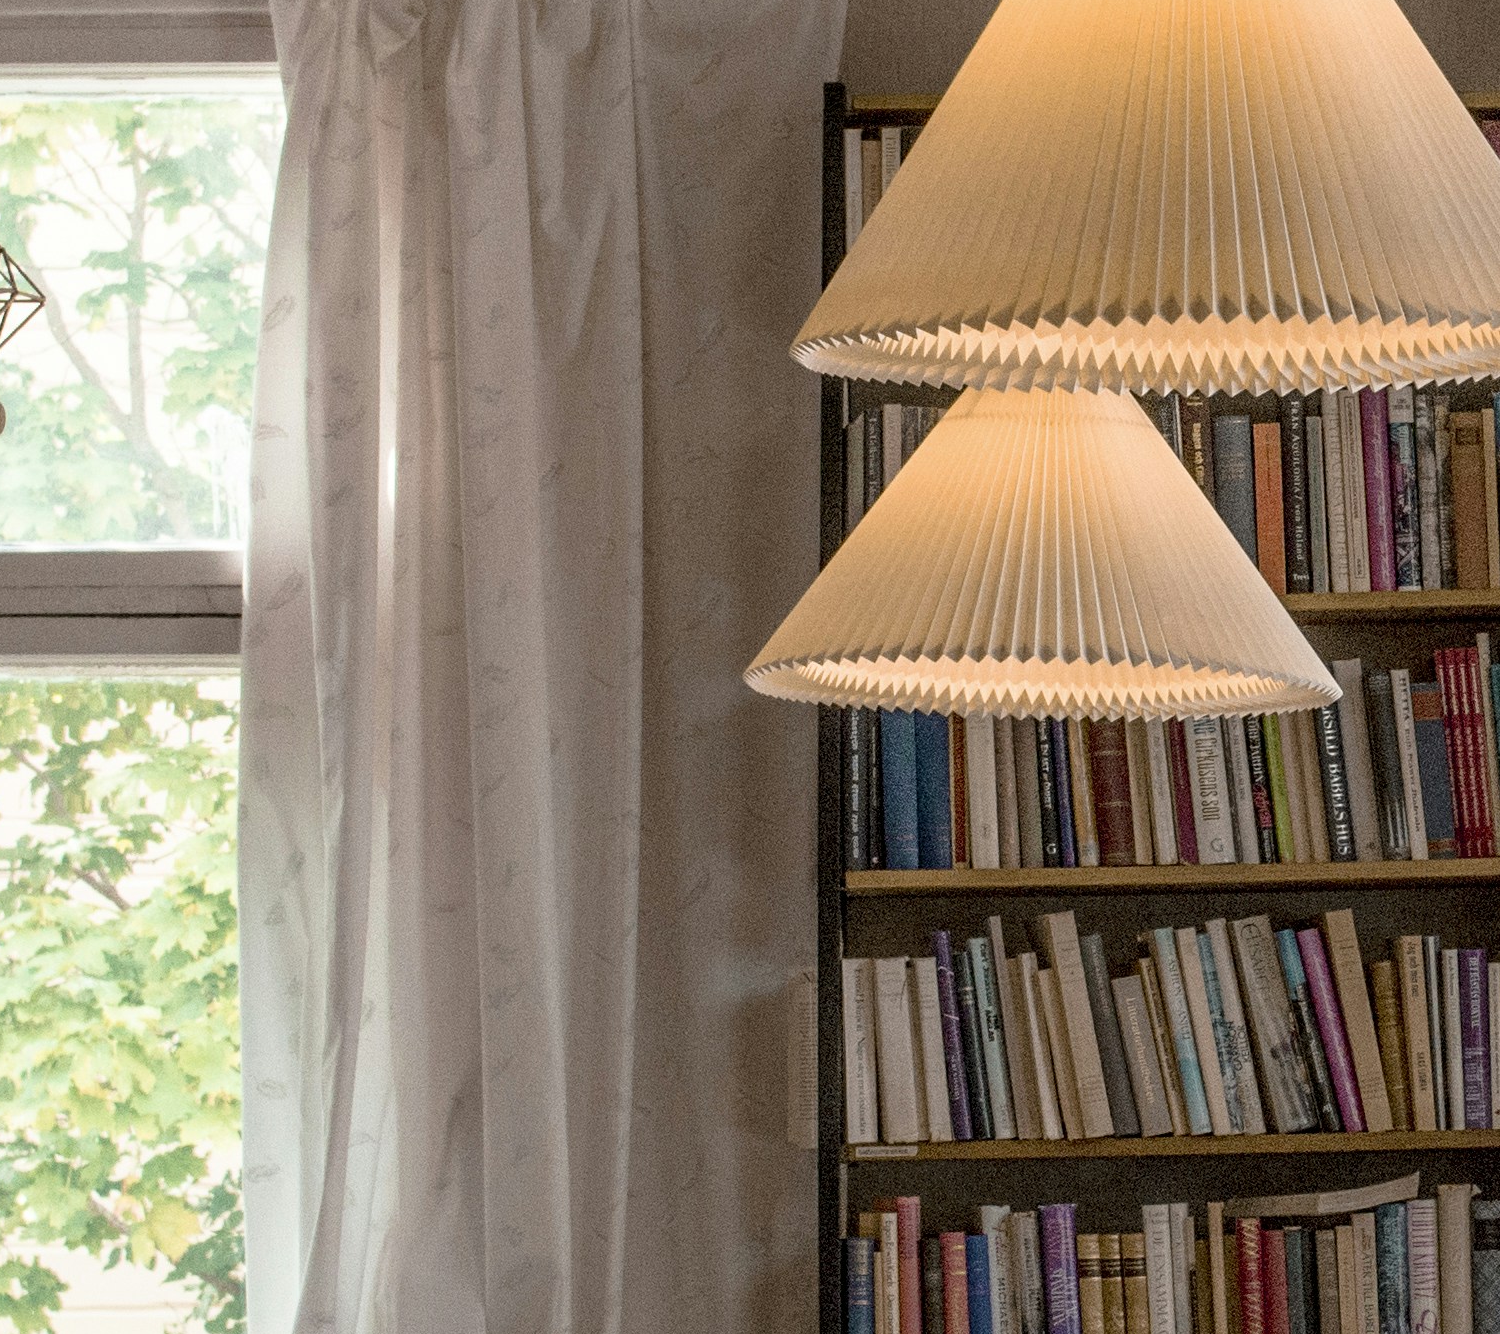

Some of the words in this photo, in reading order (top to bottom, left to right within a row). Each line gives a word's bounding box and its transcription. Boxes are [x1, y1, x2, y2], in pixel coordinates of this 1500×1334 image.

[1289, 399, 1303, 428] FRÅN
[1194, 737, 1220, 795] Cirkusens
[1326, 762, 1345, 820] BABELS
[1201, 799, 1221, 821] son
[1333, 823, 1351, 855] HUS
[997, 1276, 1011, 1334] MICHAEL
[1154, 1255, 1171, 1321] ENSAMMA
